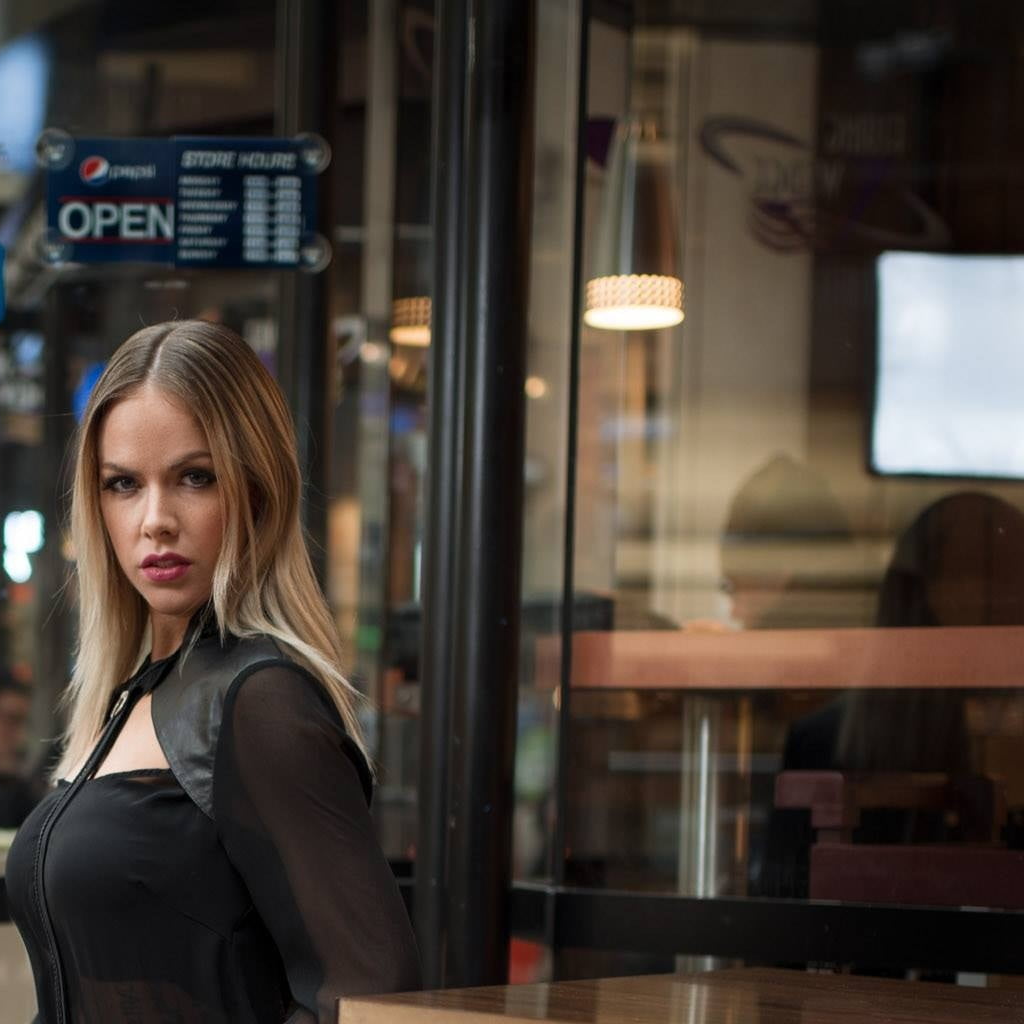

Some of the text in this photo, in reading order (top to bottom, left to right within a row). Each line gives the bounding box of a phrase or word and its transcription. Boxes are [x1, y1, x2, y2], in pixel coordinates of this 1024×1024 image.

[181, 150, 297, 170] STORE HOURS
[58, 202, 174, 239] OPEN
